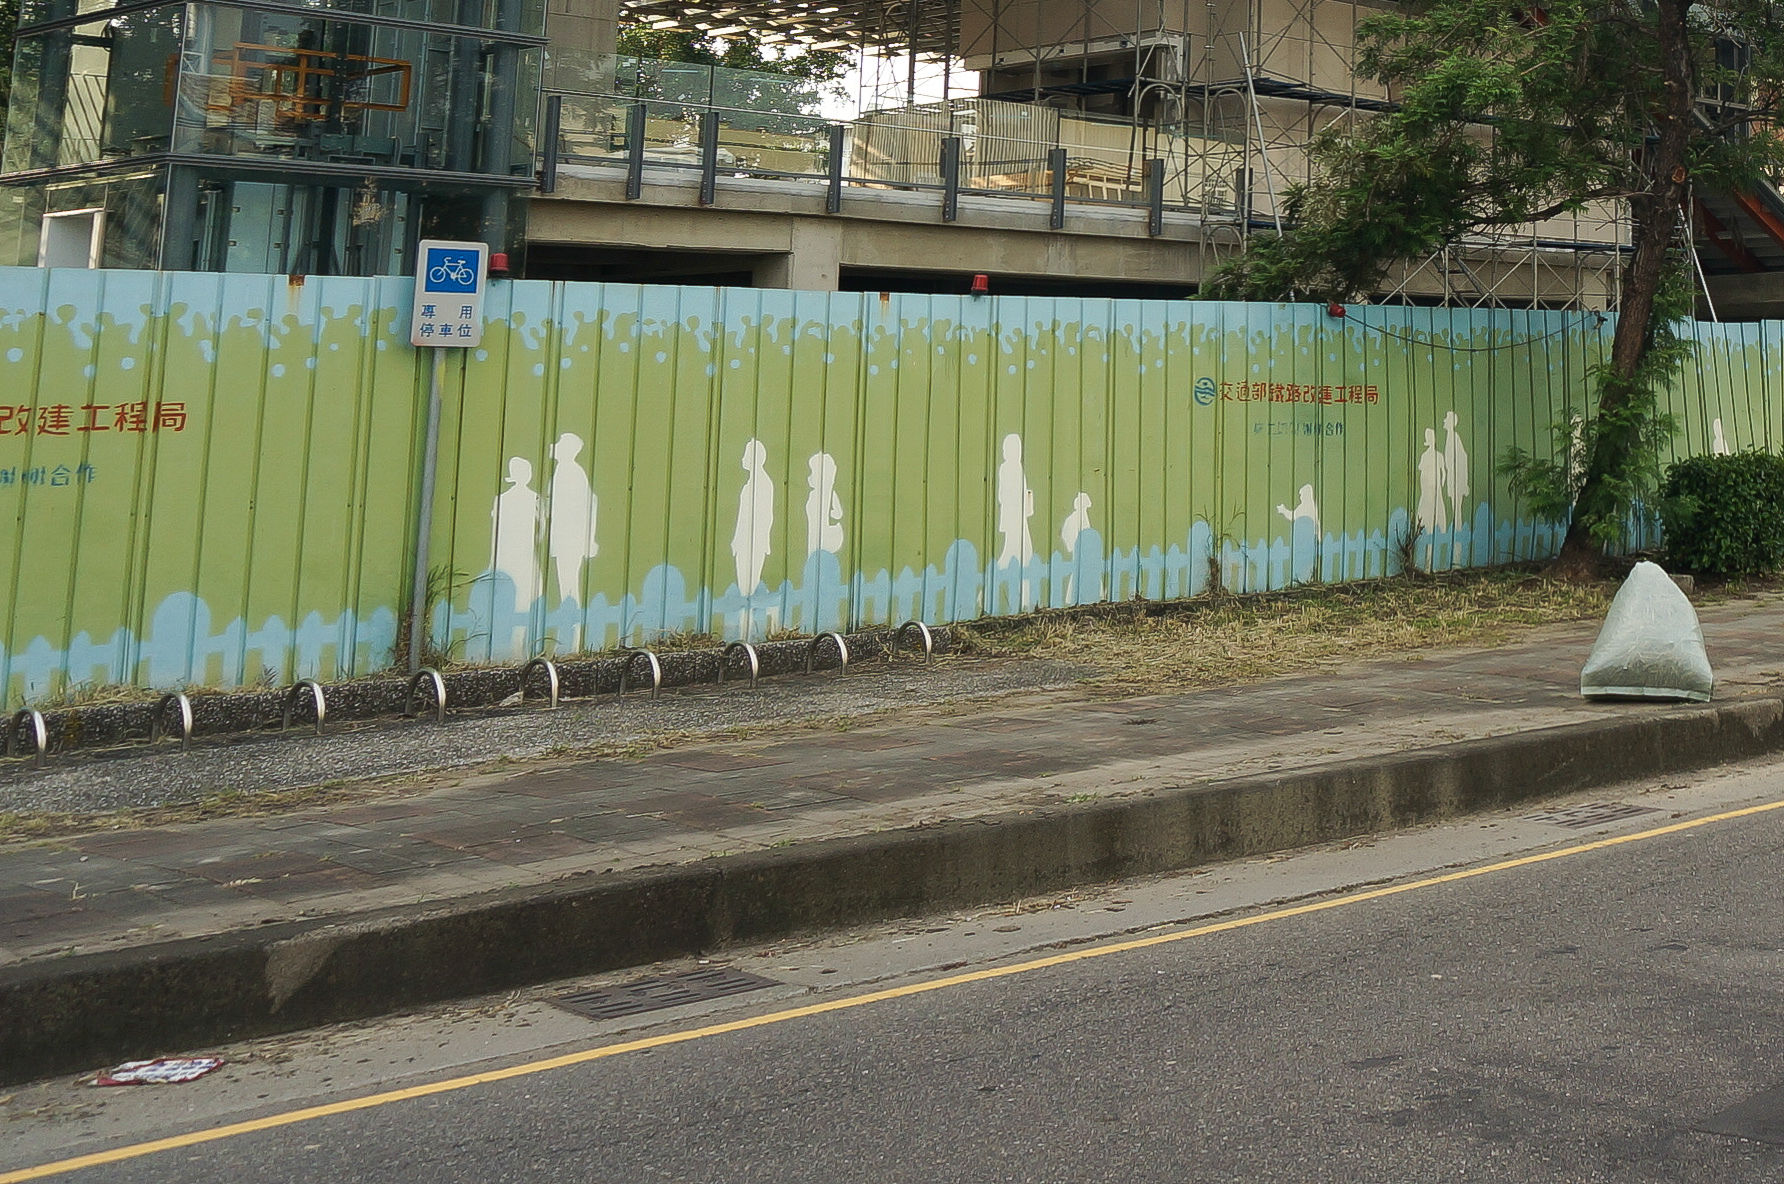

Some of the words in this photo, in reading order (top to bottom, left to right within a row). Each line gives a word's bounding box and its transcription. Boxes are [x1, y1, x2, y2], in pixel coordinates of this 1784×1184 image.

[421, 304, 473, 319] 專用
[420, 323, 472, 337] 停車位
